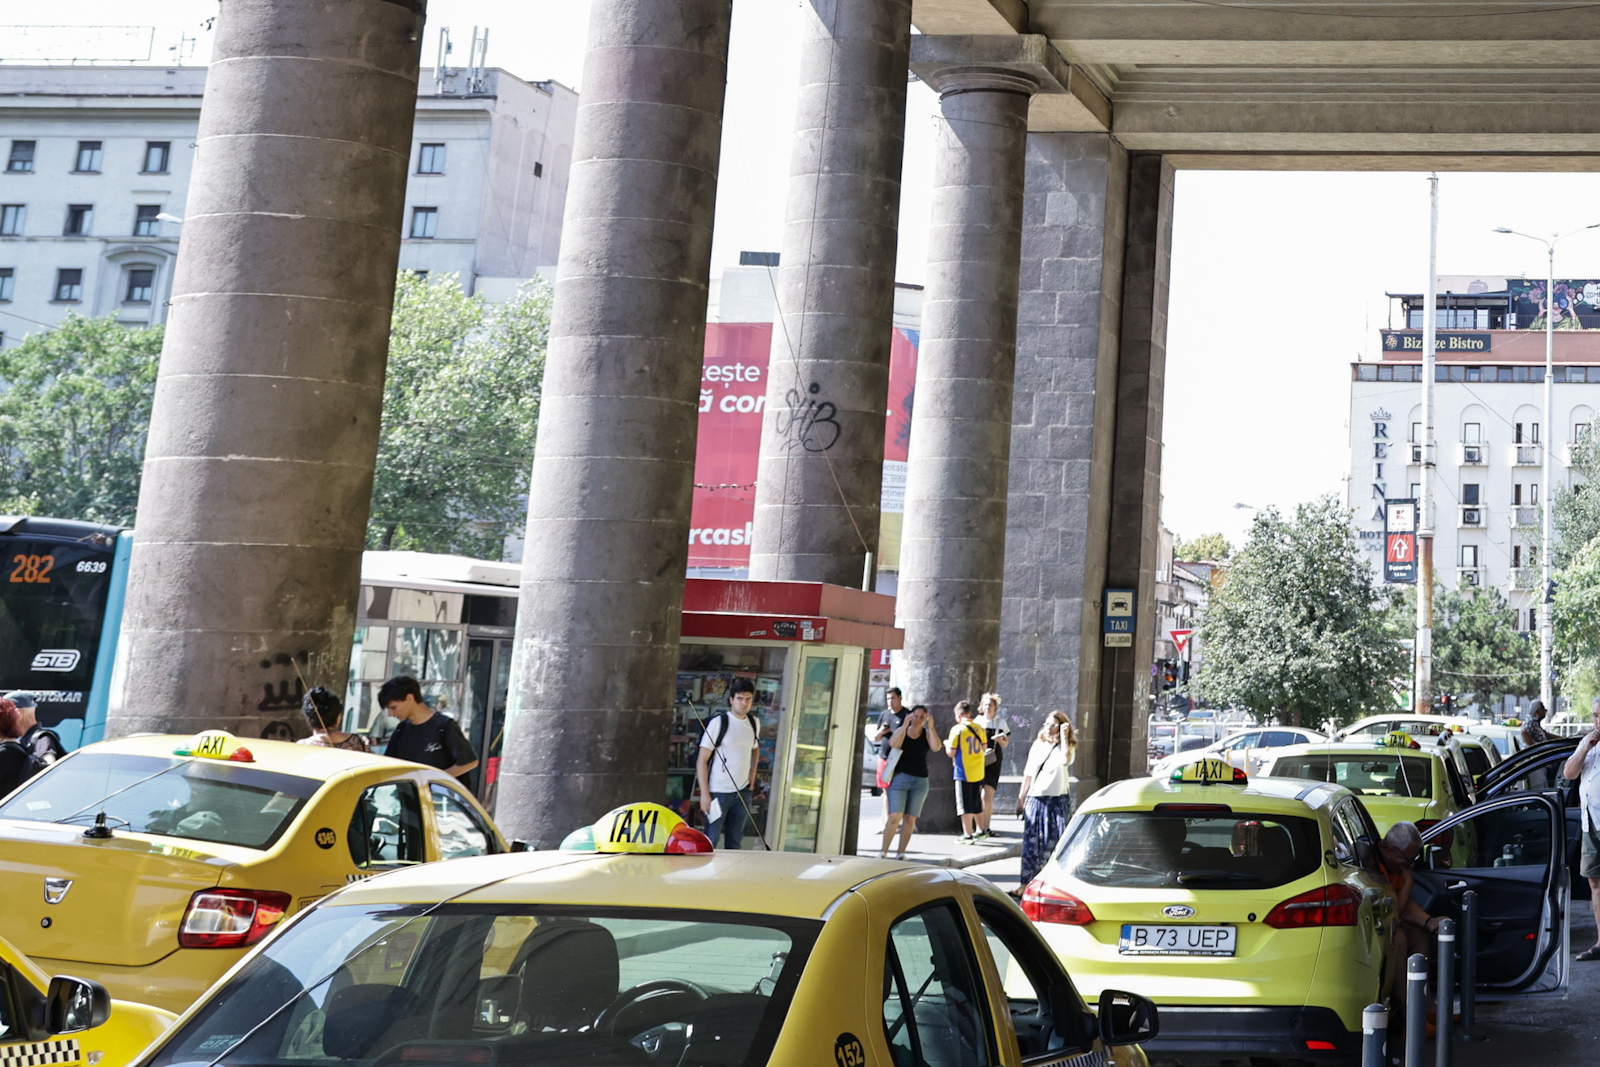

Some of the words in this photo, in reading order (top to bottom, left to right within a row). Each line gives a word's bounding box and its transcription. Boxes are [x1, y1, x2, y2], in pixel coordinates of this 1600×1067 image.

[1449, 336, 1484, 349] Bistro
[1371, 421, 1389, 521] REINA
[1359, 531, 1384, 539] HOT
[10, 555, 54, 583] 282
[76, 561, 107, 573] 6639
[1110, 620, 1128, 631] TAXI
[32, 653, 76, 668] STB
[1411, 725, 1426, 735] TAXI
[197, 735, 226, 754] TAXI
[966, 736, 980, 754] 10
[1390, 735, 1405, 746] TAXI
[1195, 761, 1222, 779] TAXI
[609, 809, 659, 843] TAXI
[1135, 928, 1148, 946] B
[1155, 929, 1178, 947] 73
[1187, 929, 1229, 948] UEP
[837, 1040, 864, 1067] 152
